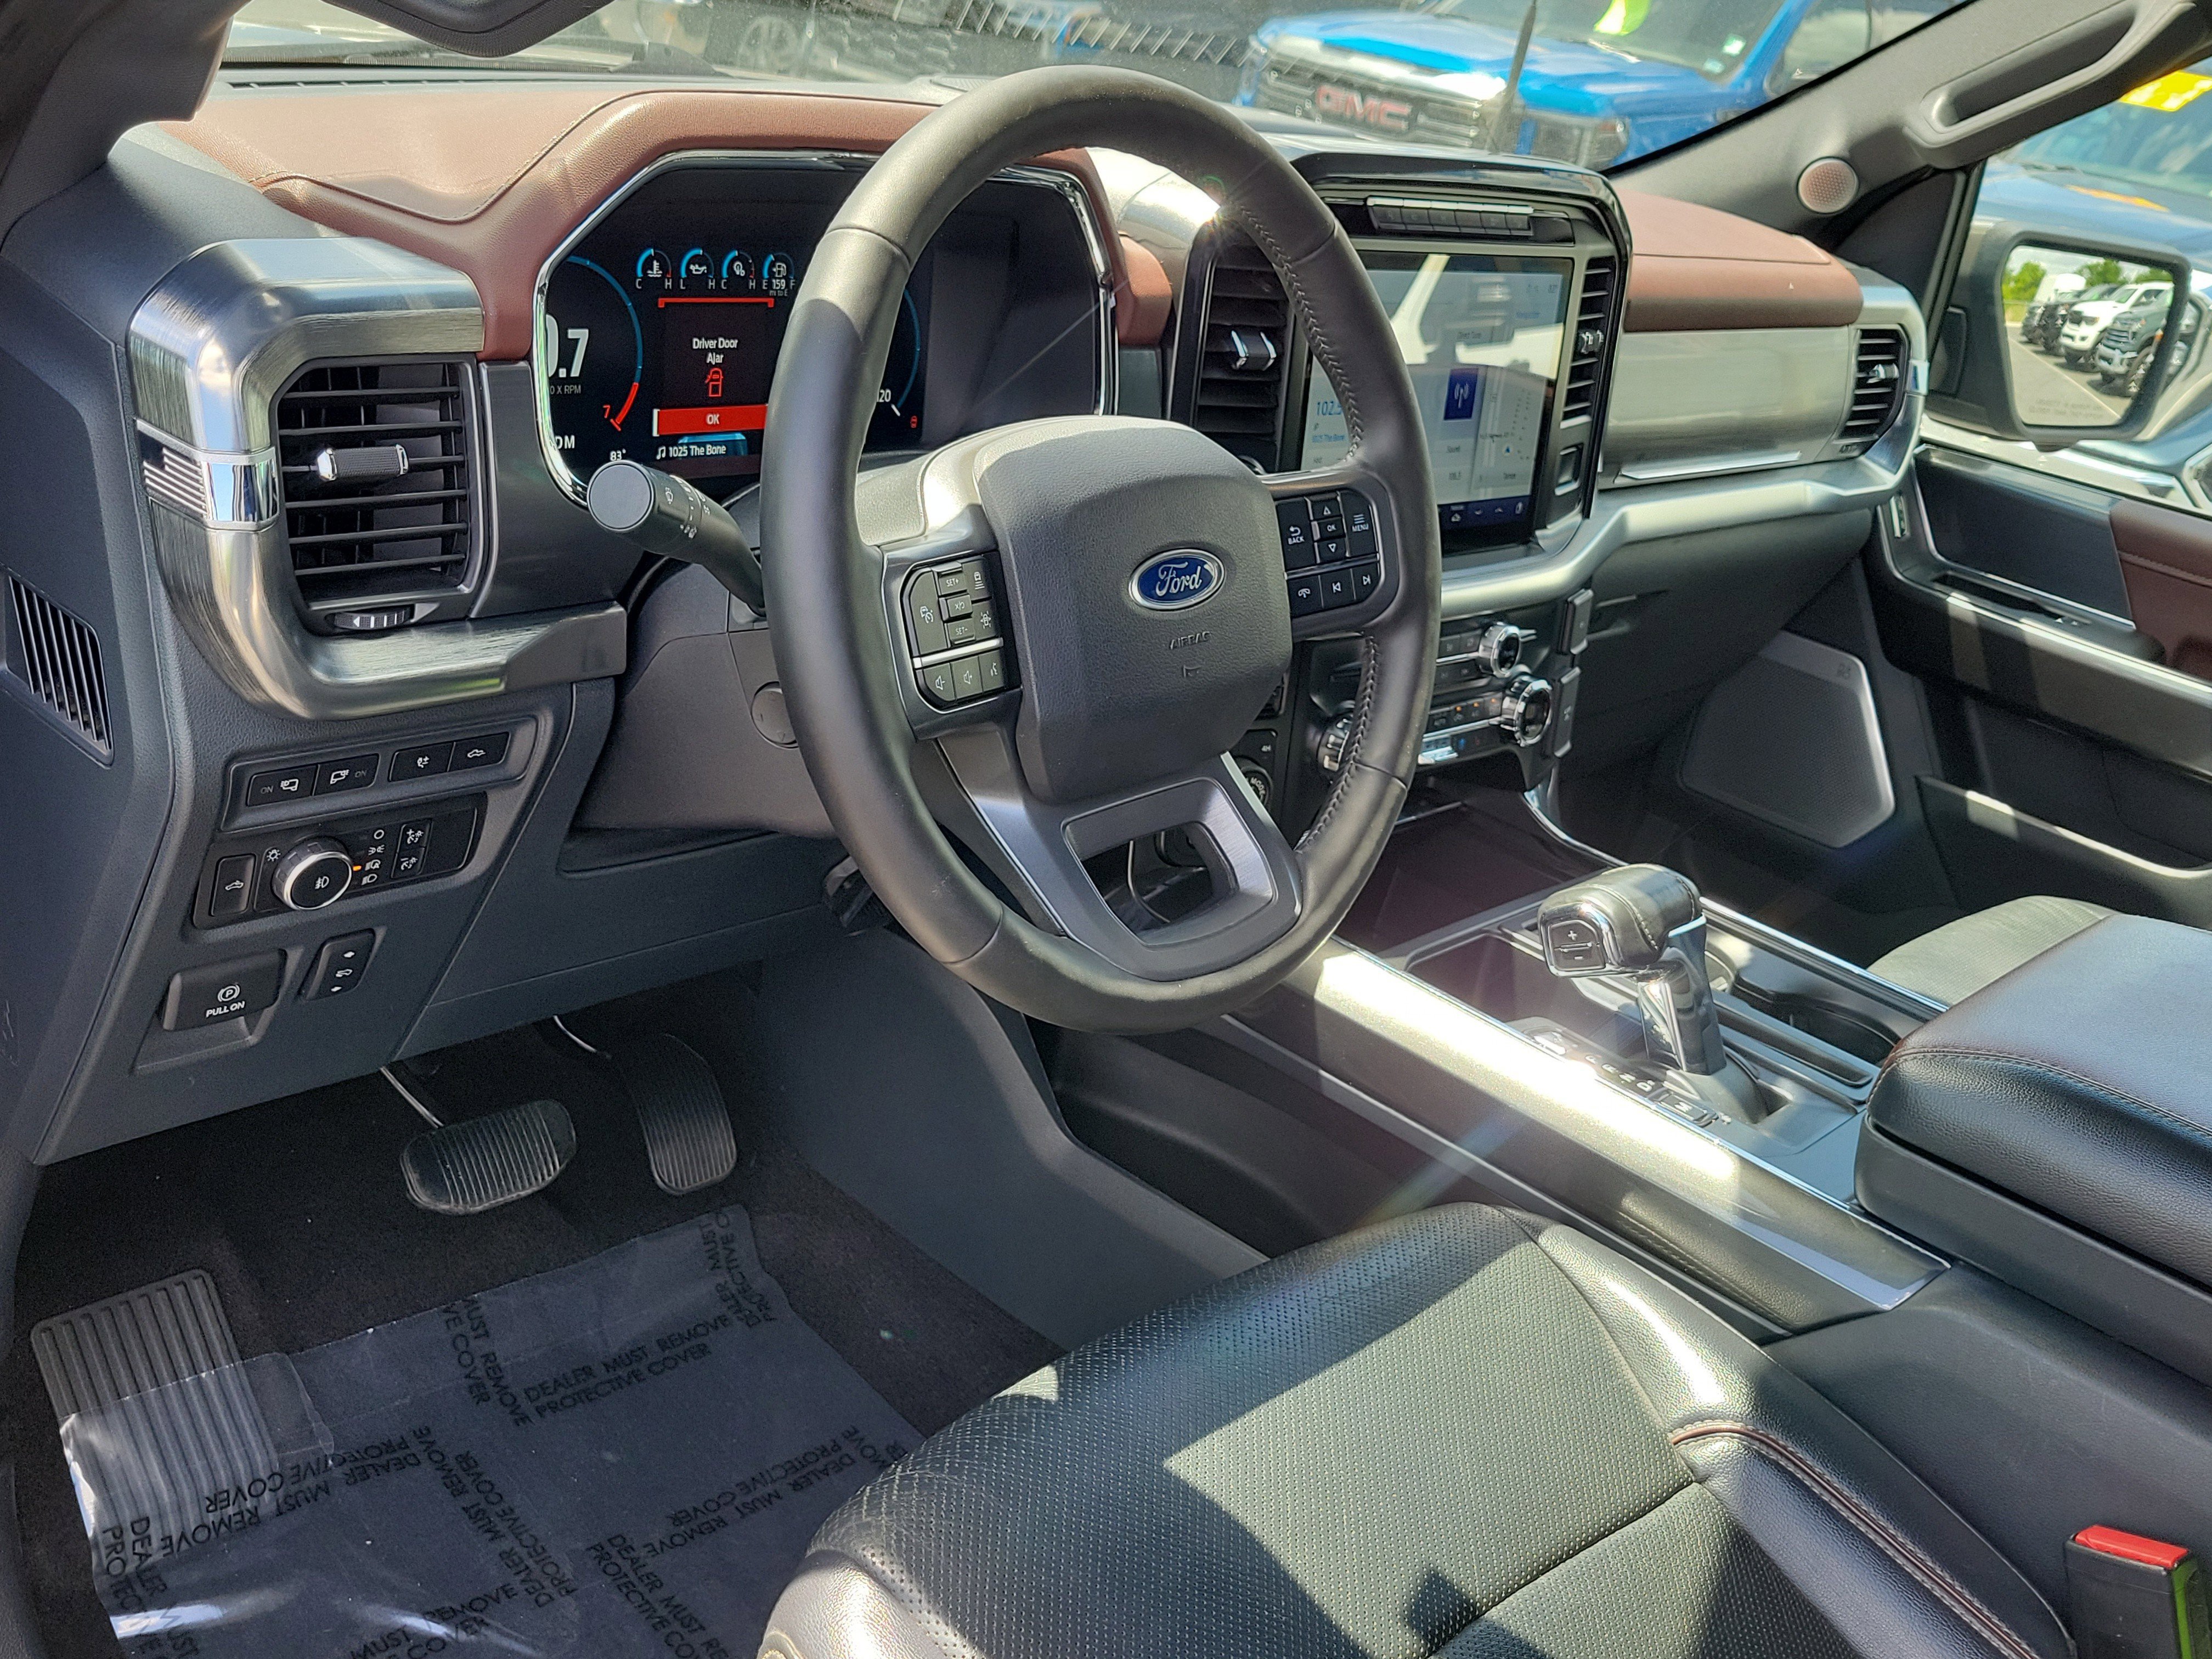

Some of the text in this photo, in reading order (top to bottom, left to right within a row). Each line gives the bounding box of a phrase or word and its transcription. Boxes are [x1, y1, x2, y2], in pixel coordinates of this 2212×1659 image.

[1316, 84, 1412, 131] GMC
[772, 279, 786, 290] 159
[692, 337, 738, 349] Driver Door
[706, 352, 724, 364] Ajar
[564, 385, 581, 394] RPM
[603, 405, 611, 418] 7
[706, 414, 719, 425] OK
[669, 444, 726, 457] 1025 The Bone
[1288, 536, 1305, 545] BACK
[1352, 523, 1369, 532] MENU
[1155, 561, 1203, 597] Ford
[260, 786, 273, 795] ON
[206, 1001, 245, 1018] PULL ON
[452, 1333, 491, 1406] COVER
[523, 1314, 732, 1404] DEALER MUST REMOVE
[535, 1342, 712, 1418] PROTECTIVE COVER
[480, 1352, 536, 1427] REMOVE
[204, 1435, 410, 1514] PROTECTIVE COVER
[664, 1438, 843, 1528] PROTECTIVE COVER
[160, 1452, 421, 1558] DEALER MUST REMOVE
[413, 1426, 555, 1608] DEALER MUST REMOVE
[455, 1451, 579, 1597] PROTECTIVE COVER
[642, 1453, 856, 1558] DEALER MUST REMOVE
[131, 1516, 168, 1596] DEALER
[607, 1534, 664, 1593] DEALER
[658, 1590, 707, 1634] MUST
[585, 1542, 672, 1632] PROTECTIVE
